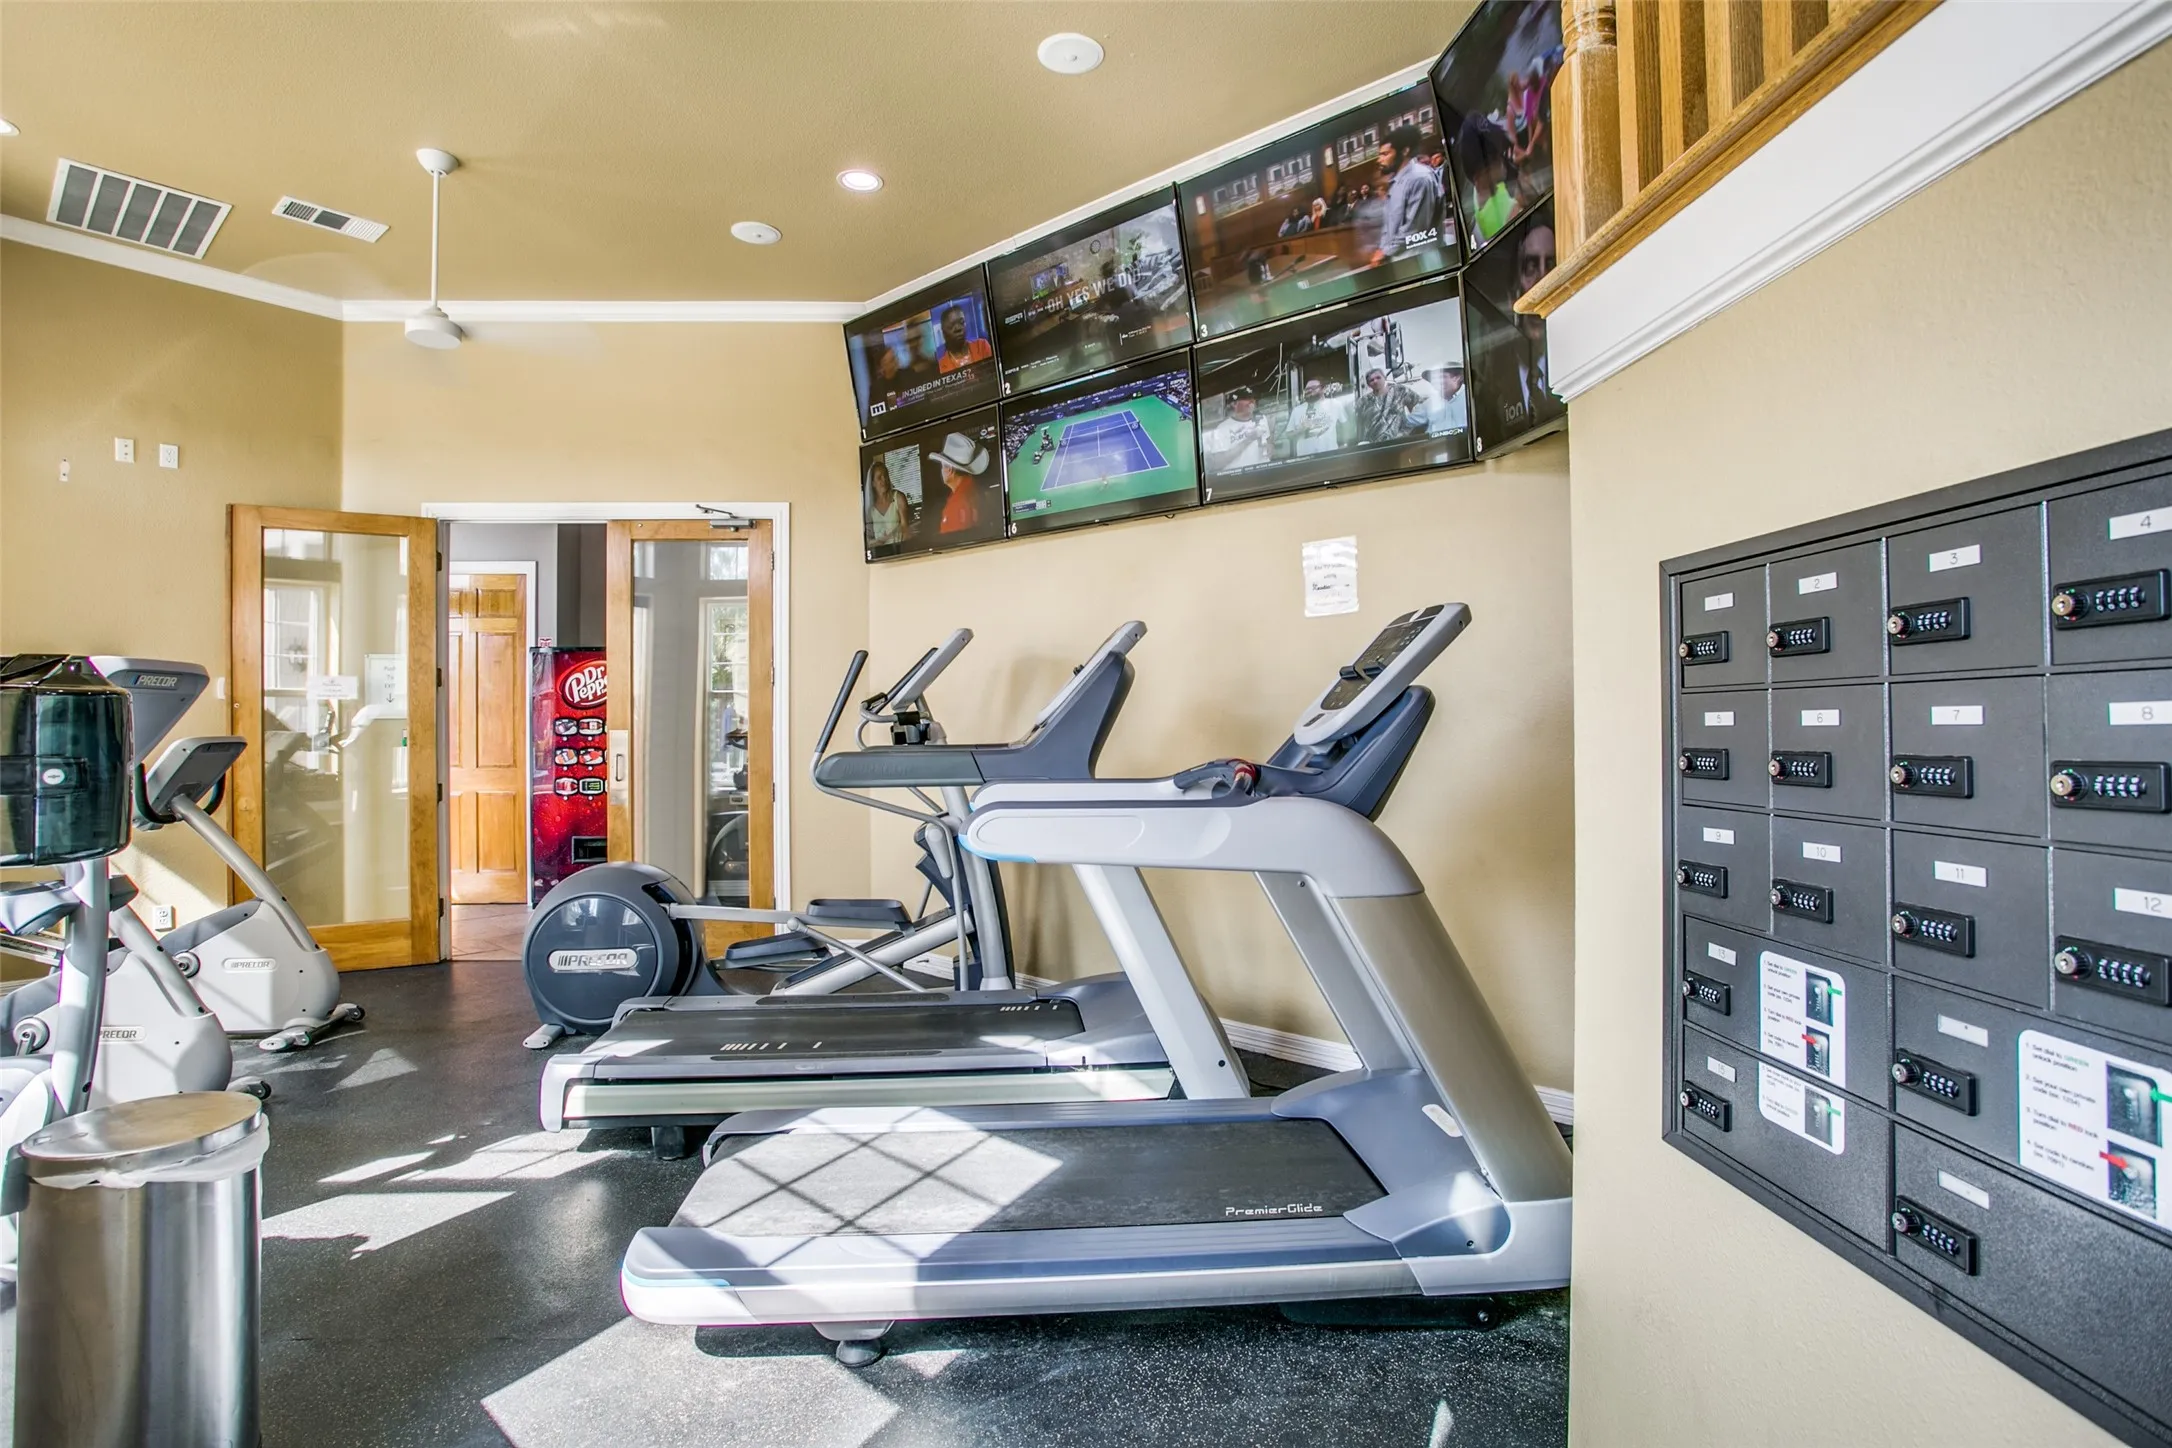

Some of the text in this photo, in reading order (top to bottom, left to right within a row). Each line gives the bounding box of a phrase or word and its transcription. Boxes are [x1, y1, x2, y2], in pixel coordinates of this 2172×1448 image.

[1405, 227, 1438, 245] FOX 4
[1093, 279, 1115, 297] WE
[1201, 324, 1208, 337] 3
[902, 382, 932, 400] INJURED
[932, 379, 942, 388] IN
[942, 368, 972, 385] TEXAS?
[1005, 382, 1011, 394] 2
[1503, 401, 1523, 421] ion
[862, 429, 867, 439] 1
[1477, 437, 1482, 452] 8
[1206, 488, 1212, 501] 7
[1011, 522, 1017, 534] 6
[2140, 515, 2152, 528] 4
[867, 550, 872, 560] 5
[1950, 552, 1958, 565] 3
[1814, 578, 1821, 589] 2
[136, 675, 178, 687] PRECOR
[583, 666, 605, 685] Dr
[1716, 714, 1723, 724] 5
[1817, 712, 1824, 724] 6
[1953, 709, 1960, 721] 7
[2141, 706, 2153, 721] 8
[1715, 831, 1722, 841] 9
[1815, 846, 1827, 858] 10
[1955, 867, 1965, 880] 11
[2144, 896, 2162, 914] 12
[567, 953, 628, 967] PRECOR
[1717, 947, 1726, 960] 13
[1225, 1203, 1323, 1216] PremierGlide
